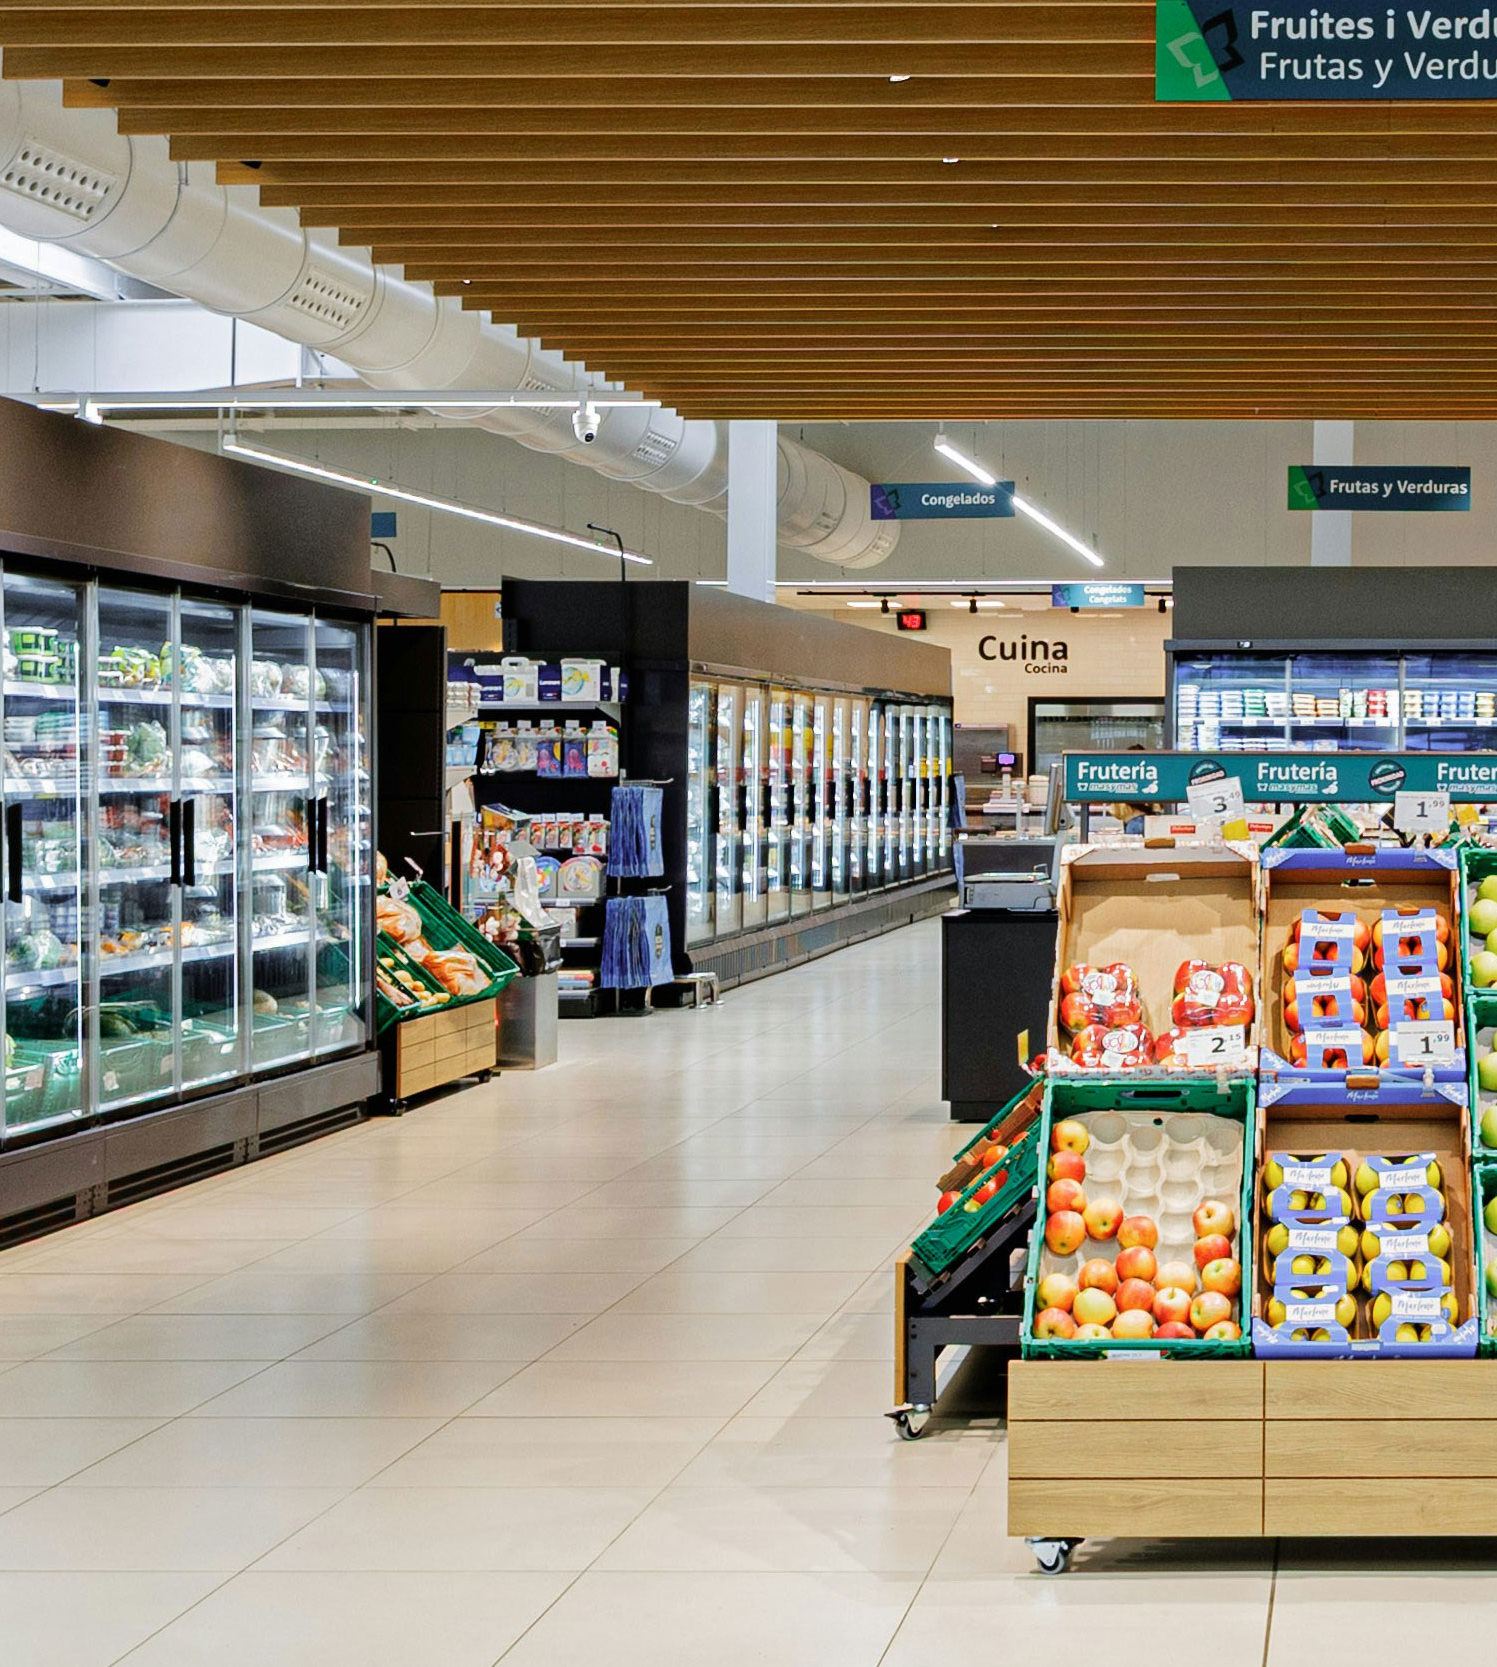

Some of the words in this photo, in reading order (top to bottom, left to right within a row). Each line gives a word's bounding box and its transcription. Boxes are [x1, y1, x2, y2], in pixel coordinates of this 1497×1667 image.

[1251, 10, 1374, 40] Fruites
[1386, 10, 1395, 39] i
[1260, 51, 1363, 79] Frutas
[1372, 57, 1393, 88] y
[1330, 480, 1379, 494] Frutas
[1382, 483, 1393, 497] y
[1397, 480, 1468, 494] Verduras
[921, 492, 995, 508] Congelados
[979, 634, 1068, 661] Cuina
[1025, 663, 1068, 674] Cocina
[1078, 761, 1158, 780] Frutería
[1257, 761, 1337, 780] Frutería
